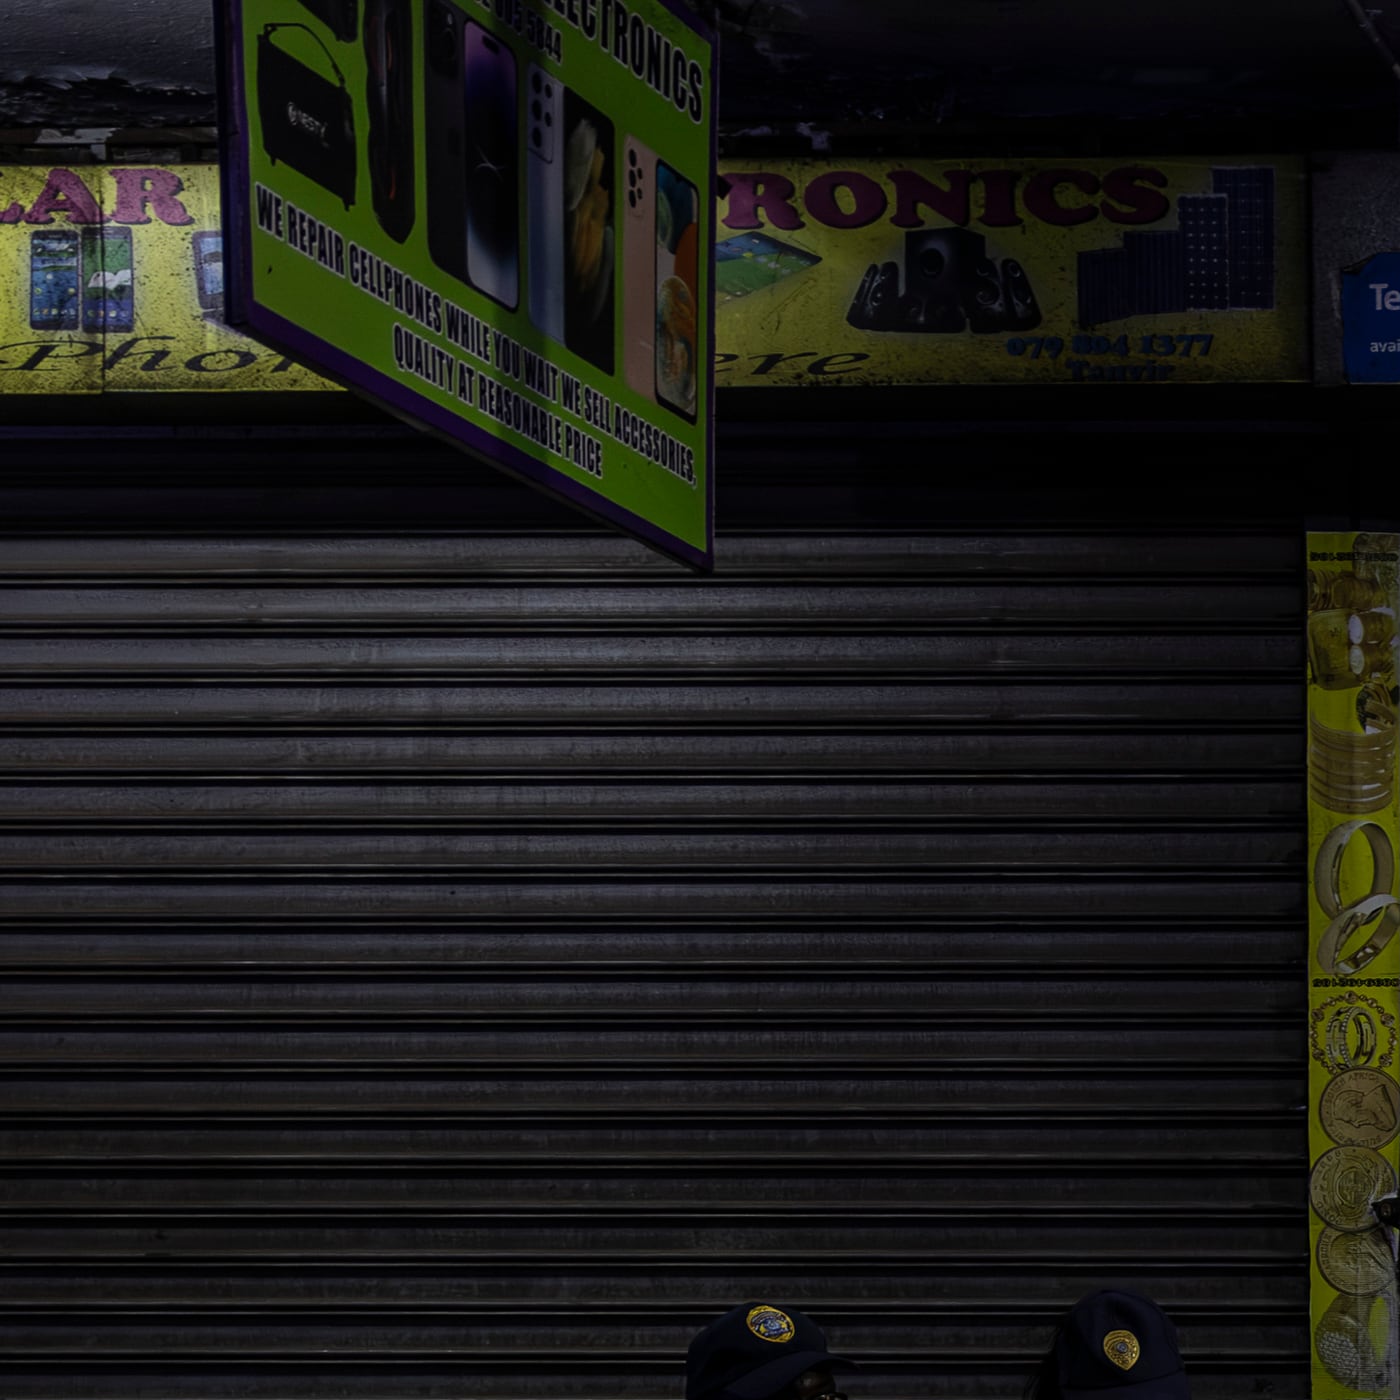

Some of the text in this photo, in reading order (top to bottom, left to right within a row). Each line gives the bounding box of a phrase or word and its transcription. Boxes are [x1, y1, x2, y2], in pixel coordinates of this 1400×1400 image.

[0, 168, 193, 225] AR
[256, 185, 697, 486] WE REPAIR CELLPHONES WHILE YOU WAIT WE SELL ACCESSORIES,
[1007, 337, 1064, 359] 079
[1139, 335, 1213, 358] 1377
[394, 325, 602, 476] QUALITY AT REASONABLE PRICE
